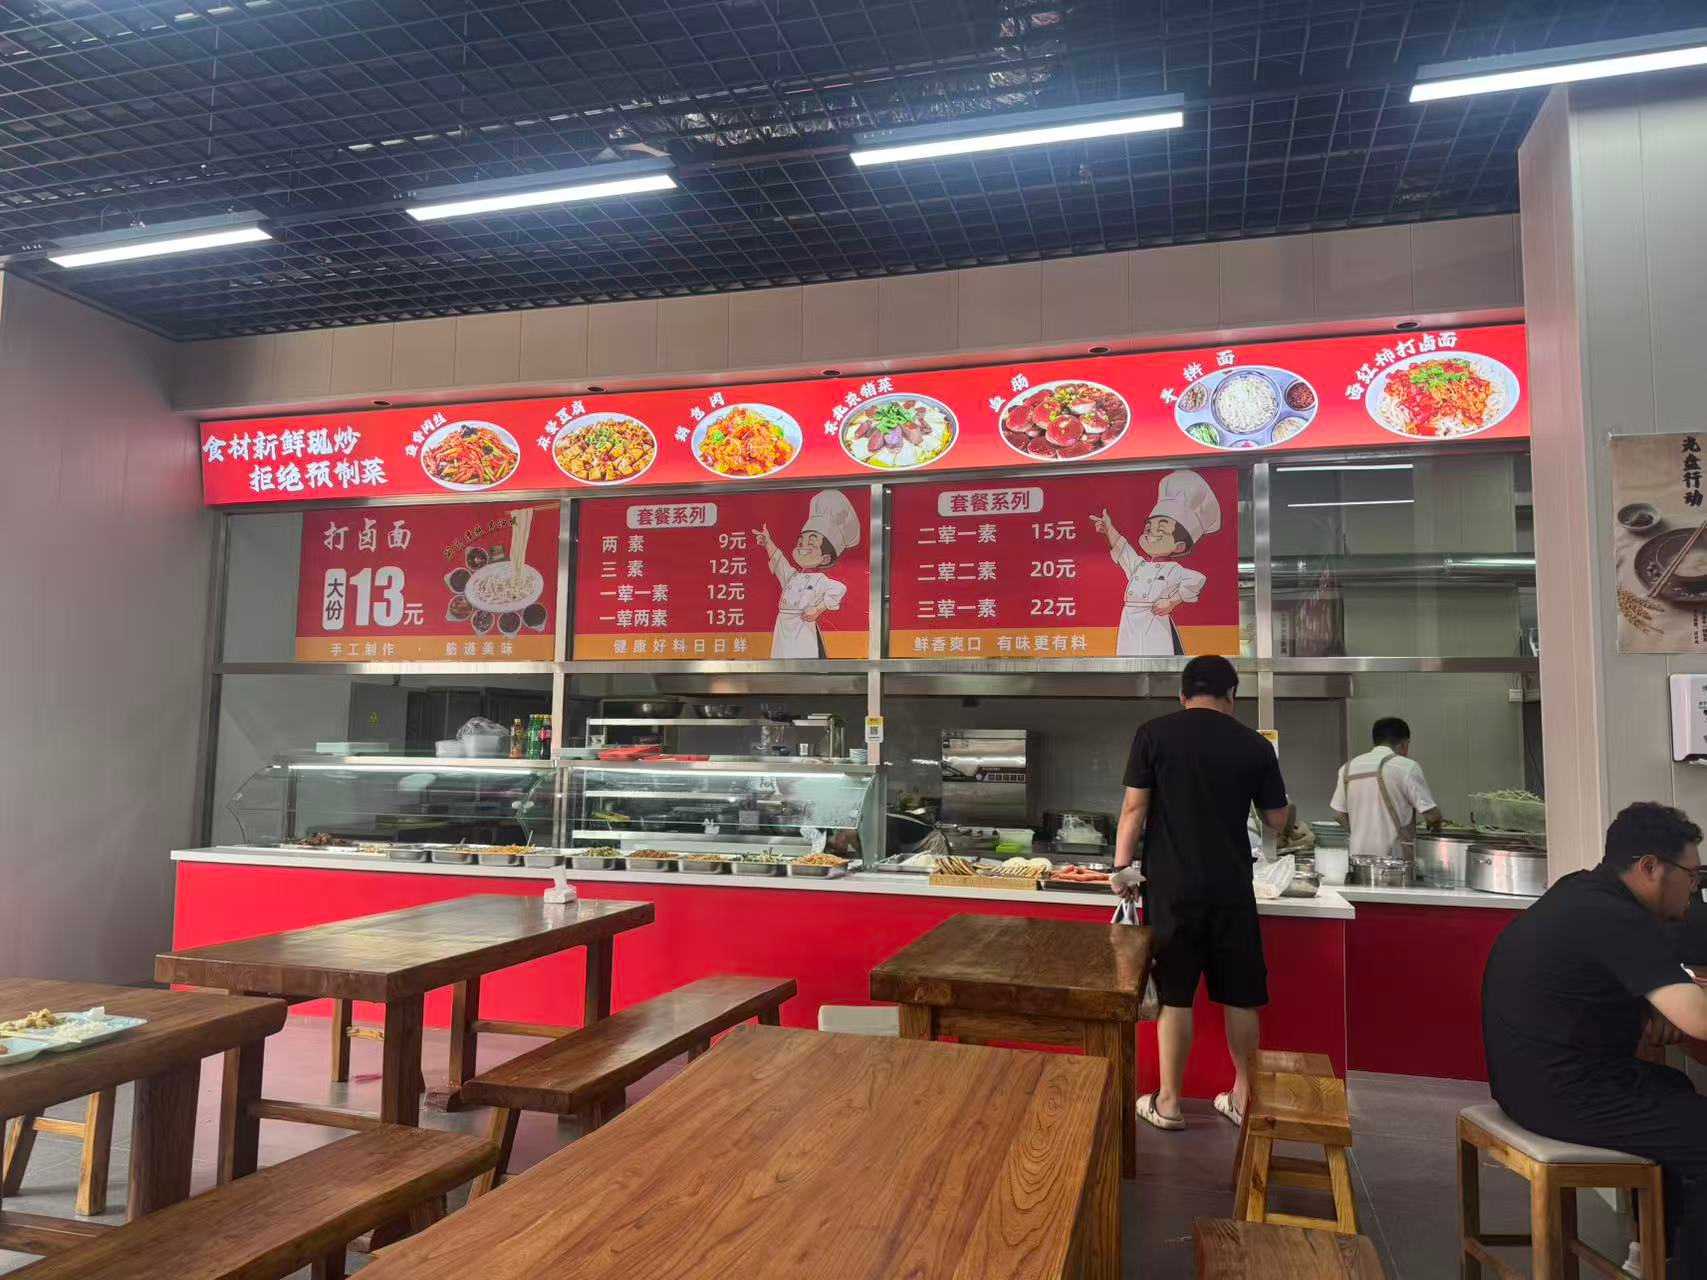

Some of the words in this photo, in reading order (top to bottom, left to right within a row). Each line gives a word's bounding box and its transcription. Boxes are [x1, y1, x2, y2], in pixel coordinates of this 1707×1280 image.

[1345, 331, 1458, 400] 西红柿打卤面
[988, 373, 1029, 413] 血肠
[536, 400, 586, 451] 麻婆豆腐
[674, 391, 725, 443] 锅包肉
[202, 426, 361, 463] 食材新鲜现炒
[404, 412, 447, 458] 鱼香肉丝
[249, 457, 388, 492] 拒绝预制菜
[1682, 435, 1703, 506] 光盘行动
[951, 490, 1030, 512] 套餐系列
[638, 506, 705, 526] 套餐系列
[324, 518, 412, 552] 打卤面
[719, 532, 747, 550] 9元
[917, 524, 997, 544] 二荤一素
[1031, 521, 1076, 540] 15元
[709, 557, 747, 575] 12元
[917, 561, 997, 581] 二荤二素
[1030, 559, 1076, 578] 20元
[326, 578, 344, 620] 大份
[600, 584, 669, 602] 一荤一素
[707, 582, 745, 601] 12元
[600, 609, 668, 627] 一荤两素
[706, 608, 744, 626] 13元
[917, 599, 997, 618] 三荤一素
[1030, 597, 1076, 616] 22元
[330, 641, 396, 657] 手工制作
[613, 637, 747, 654] 健康好料日日鲜
[914, 636, 981, 653] 鲜香爽口
[997, 635, 1087, 651] 有味更有料
